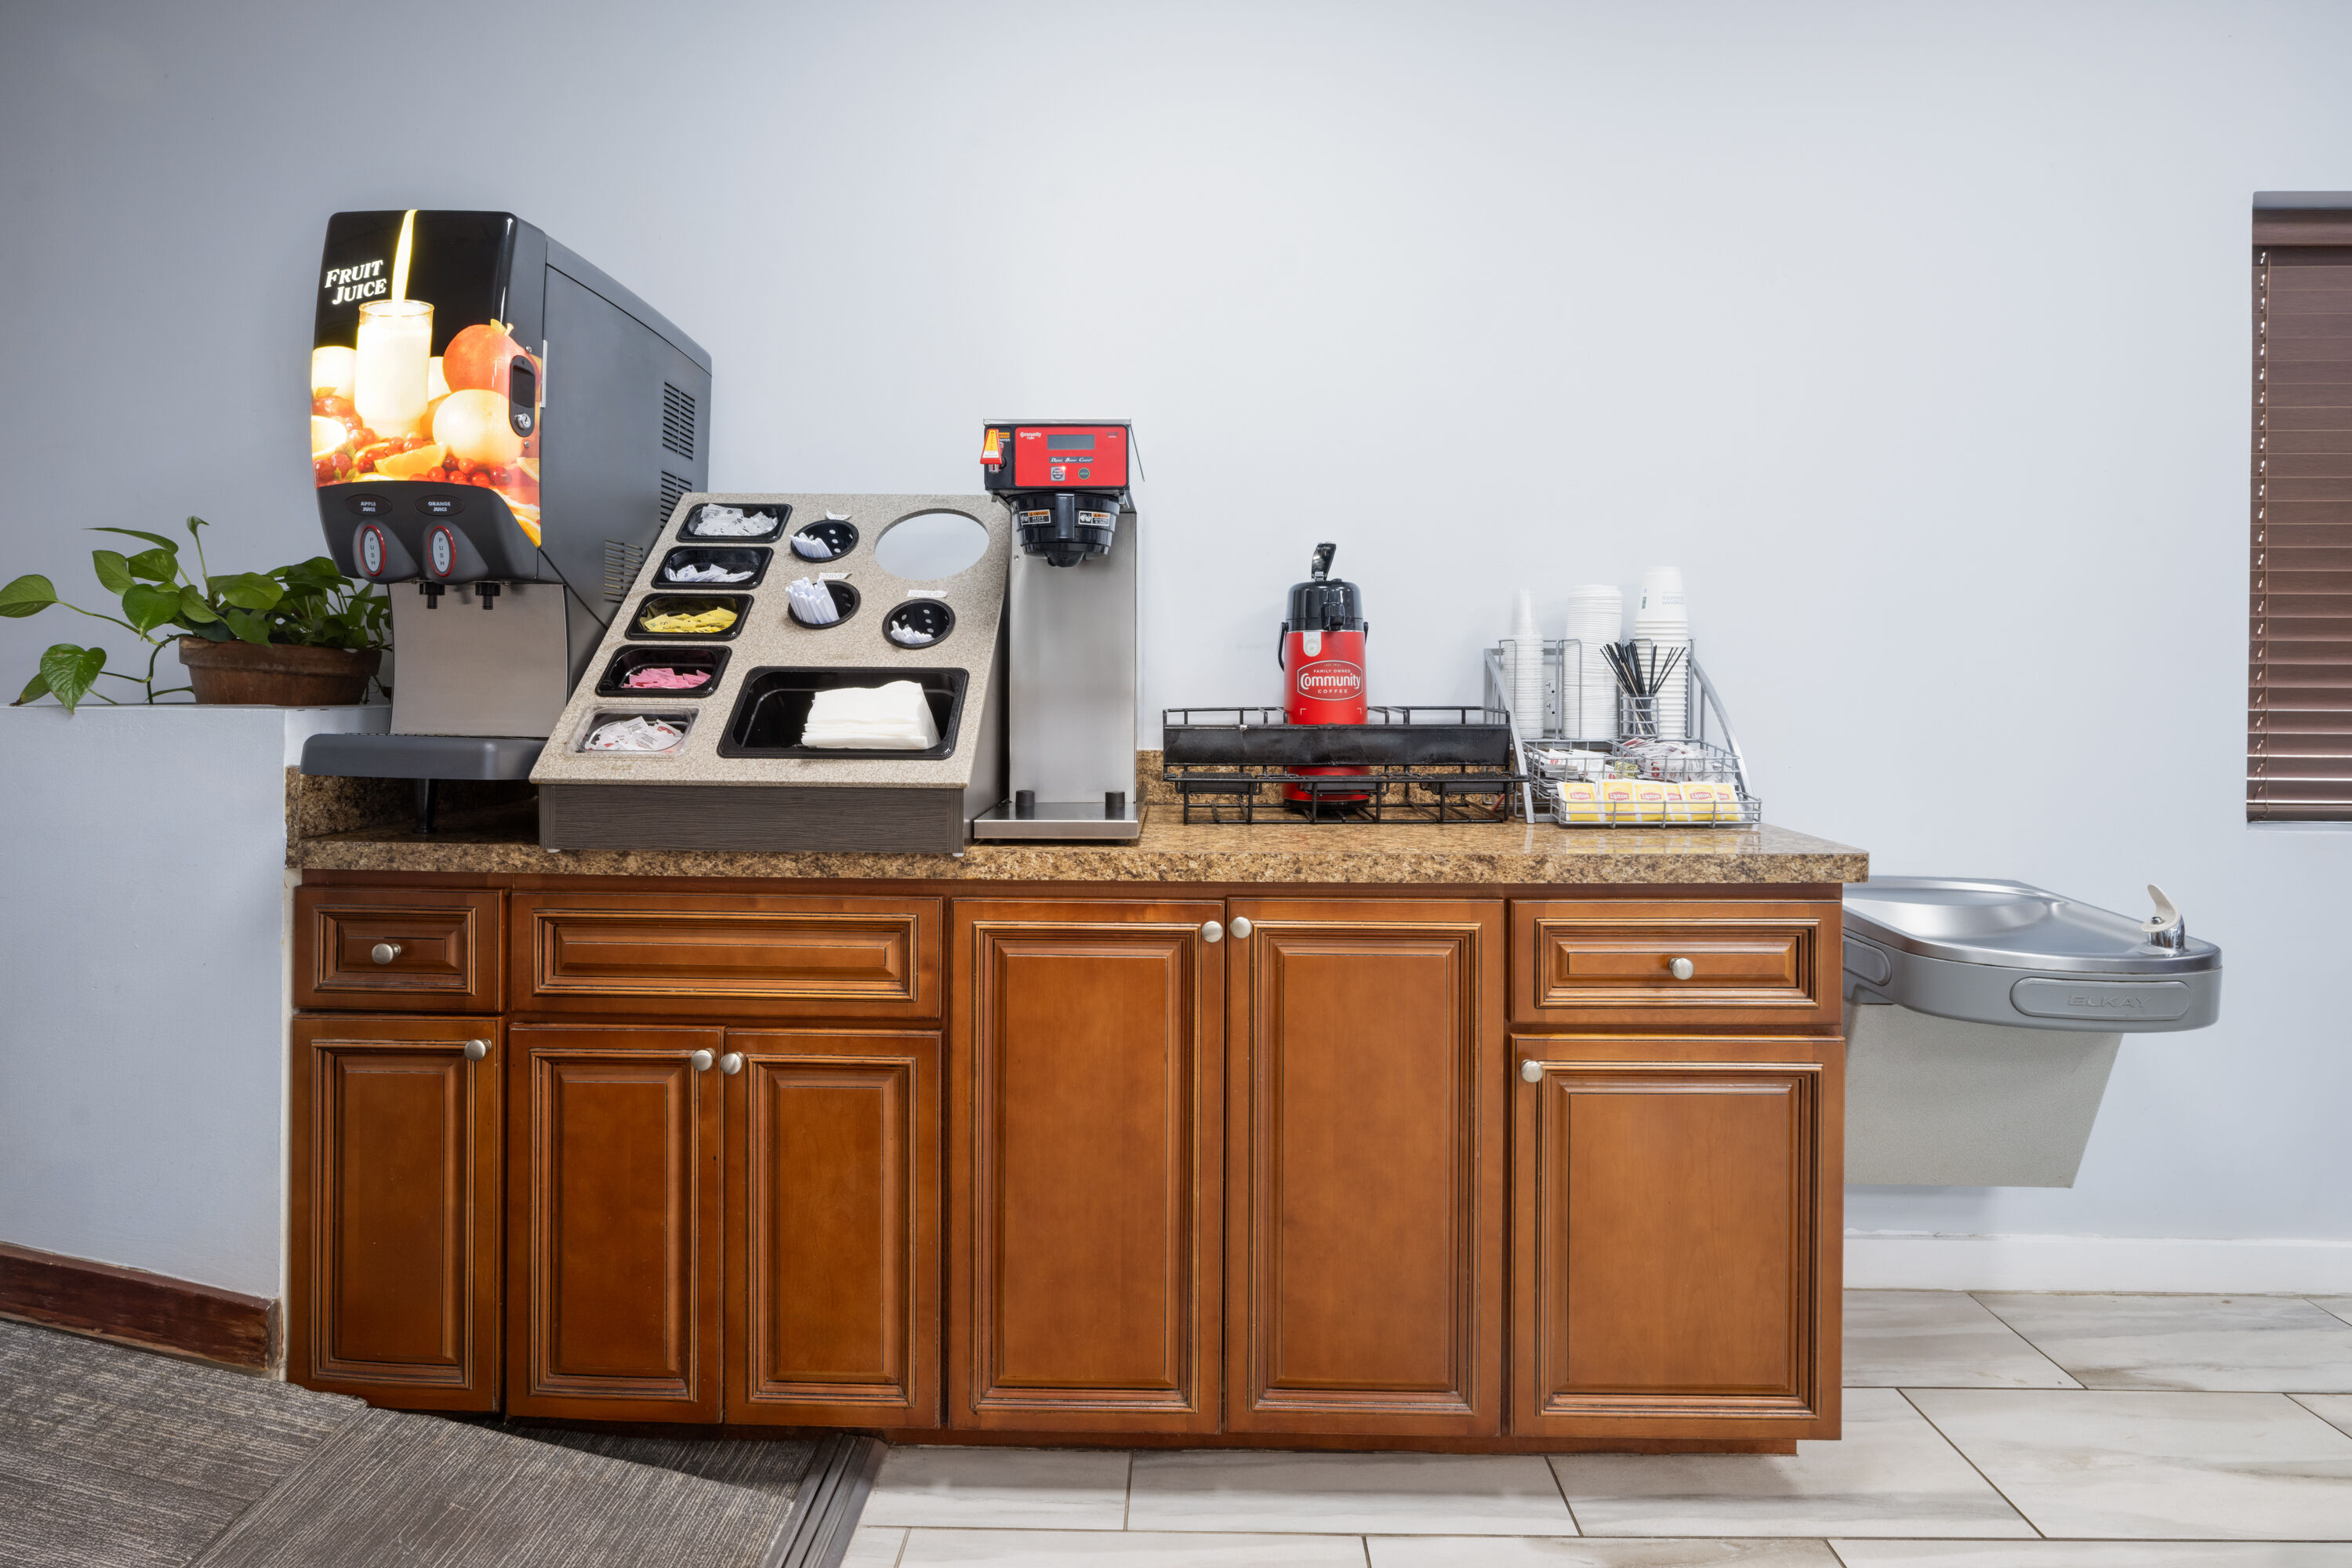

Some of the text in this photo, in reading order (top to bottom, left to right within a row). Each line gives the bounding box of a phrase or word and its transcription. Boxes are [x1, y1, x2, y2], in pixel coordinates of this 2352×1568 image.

[324, 260, 383, 289] FRUIT
[332, 278, 387, 305] JUICE
[1300, 673, 1361, 690] Community
[2067, 996, 2152, 1008] ELKAY
